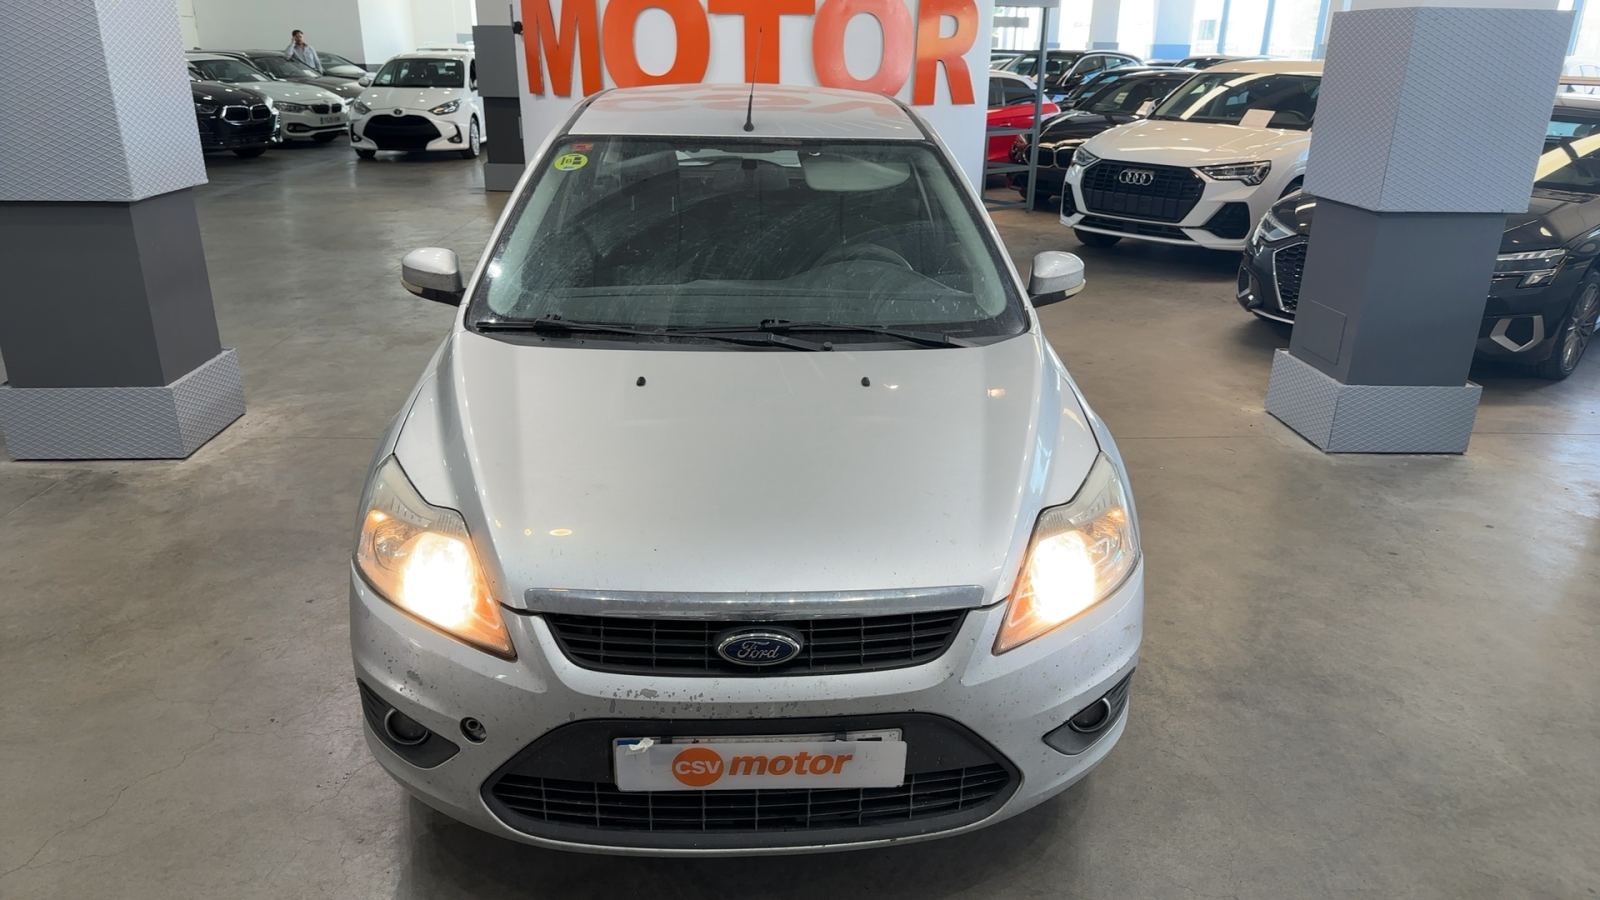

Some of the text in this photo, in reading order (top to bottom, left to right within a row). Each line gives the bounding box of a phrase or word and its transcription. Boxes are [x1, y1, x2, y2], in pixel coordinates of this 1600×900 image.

[520, 0, 979, 106] MOTOR
[737, 641, 781, 659] Ford
[728, 751, 853, 776] motor
